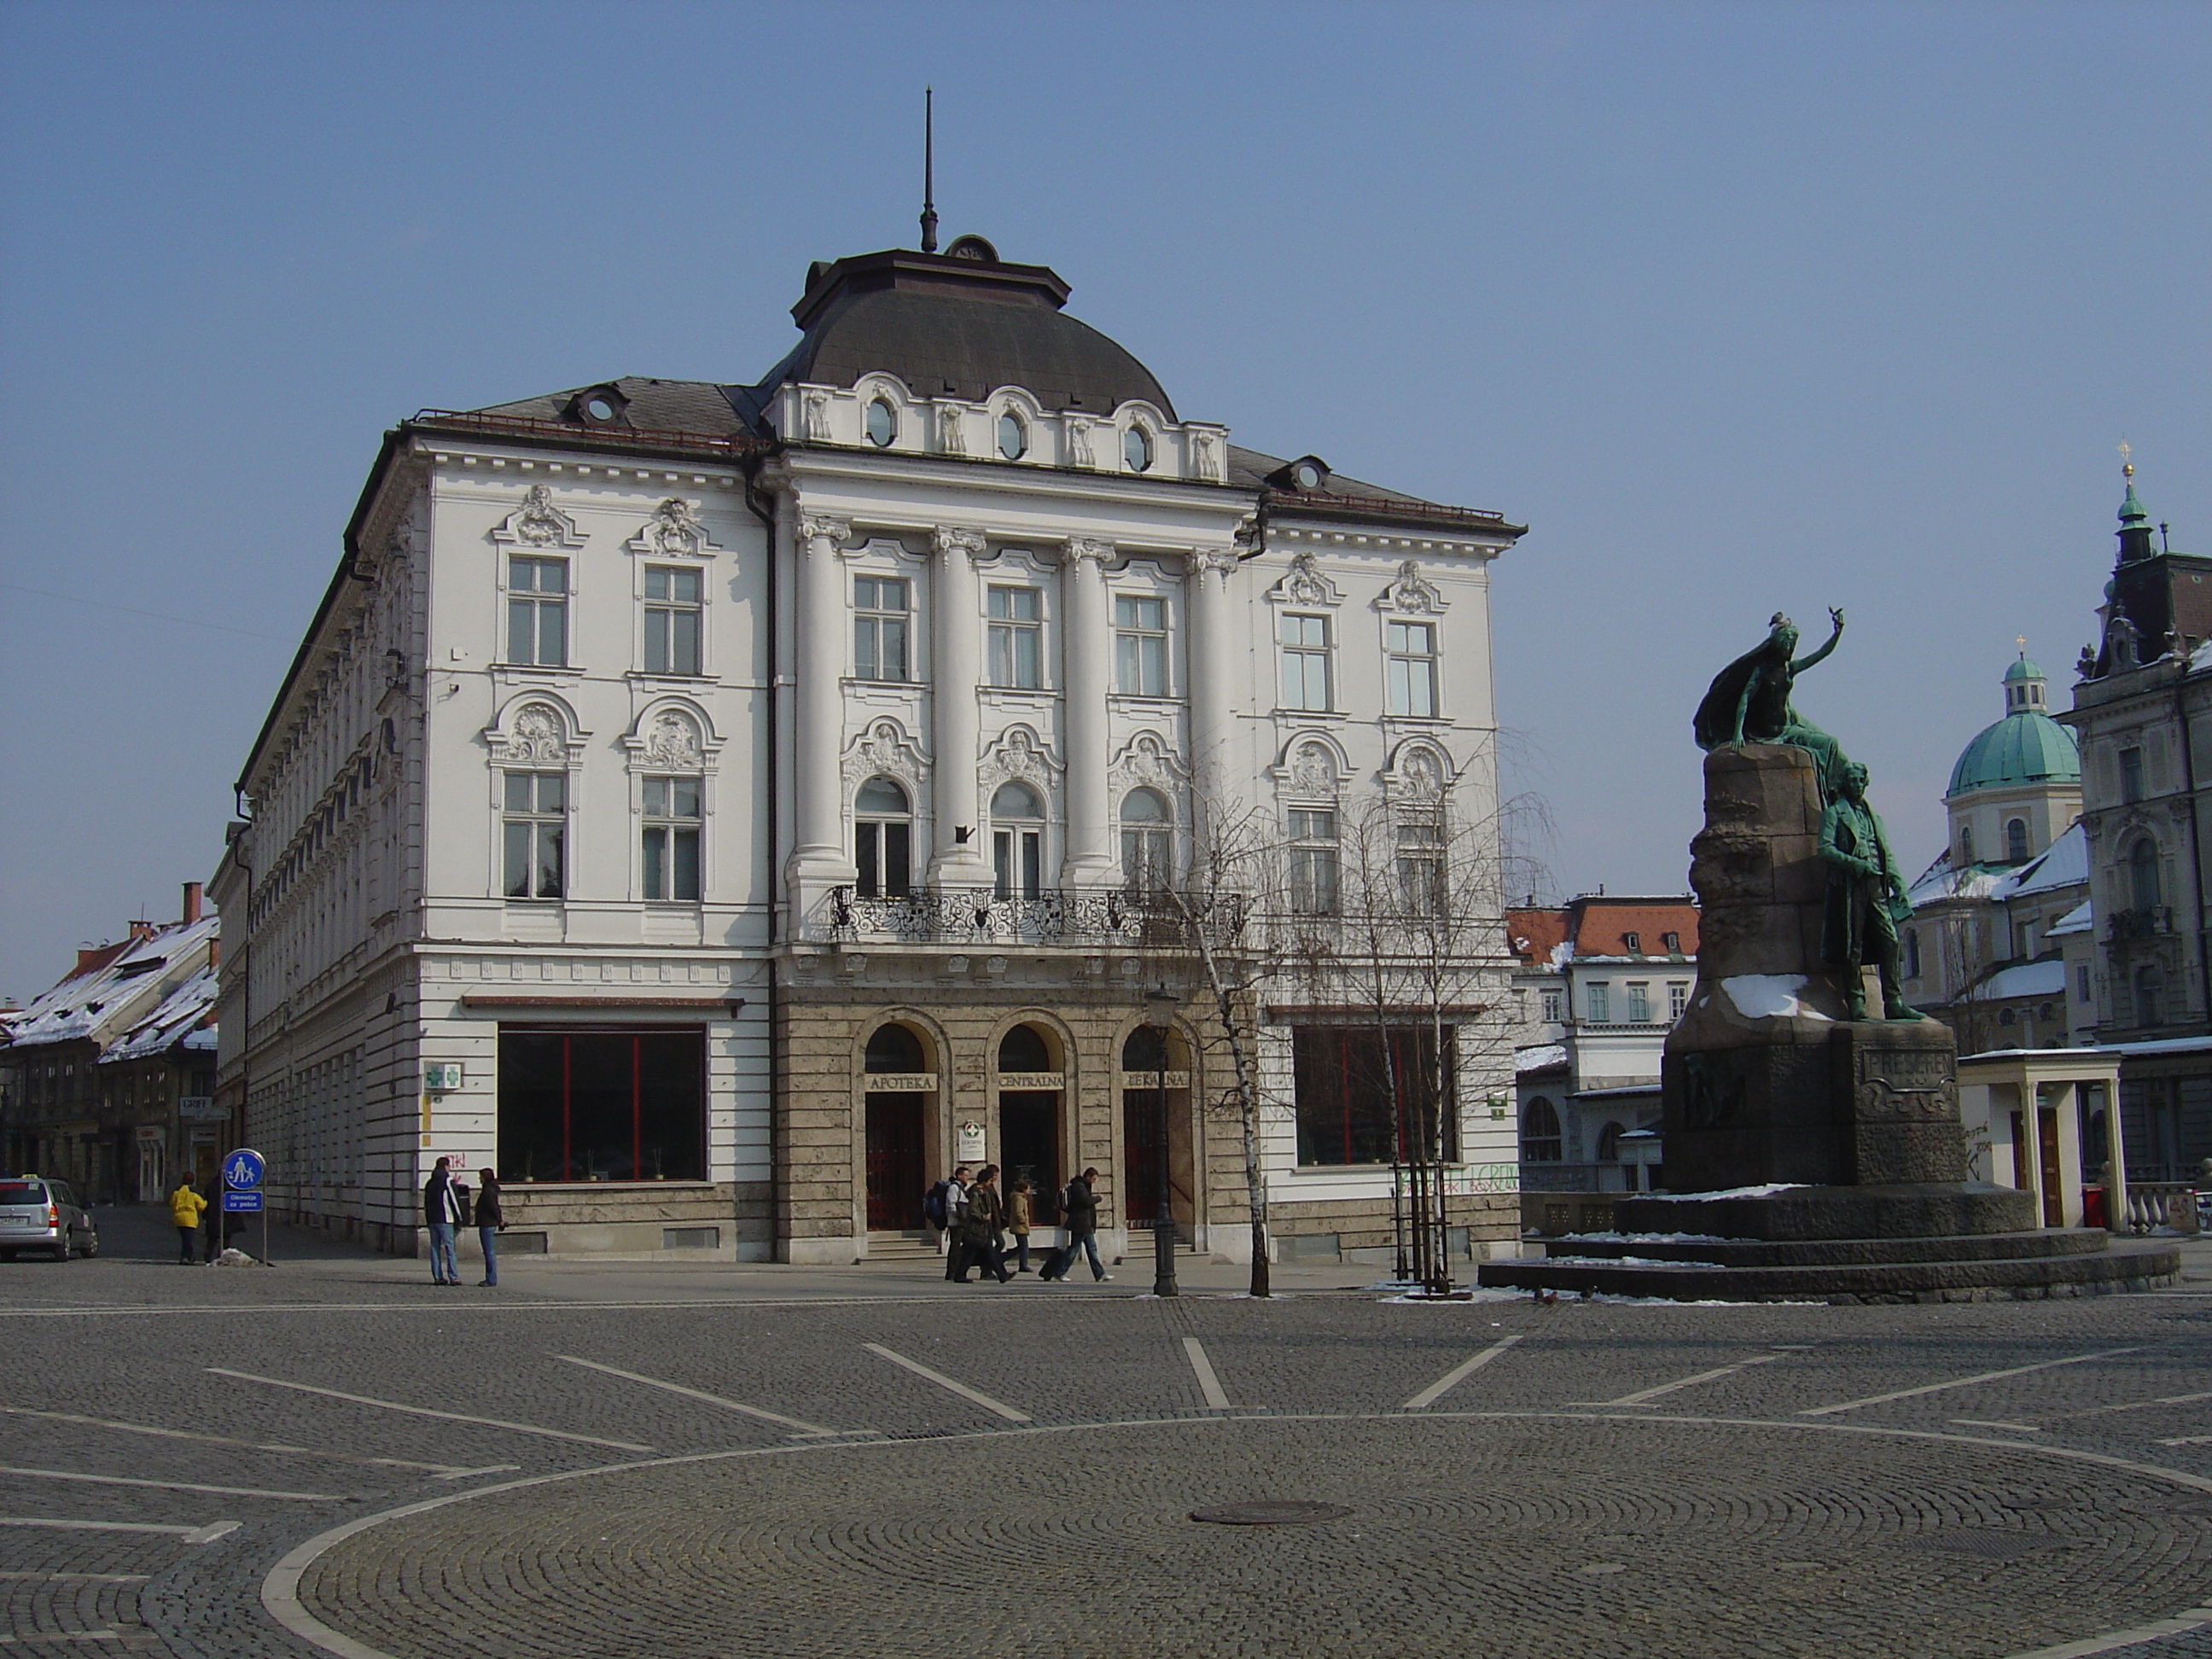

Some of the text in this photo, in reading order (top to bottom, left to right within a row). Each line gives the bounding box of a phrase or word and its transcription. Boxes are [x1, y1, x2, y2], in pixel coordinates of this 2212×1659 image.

[870, 1077, 933, 1089] APOTEKA
[999, 1076, 1065, 1086] CENTRALNA
[1128, 1074, 1186, 1086] LEKANA
